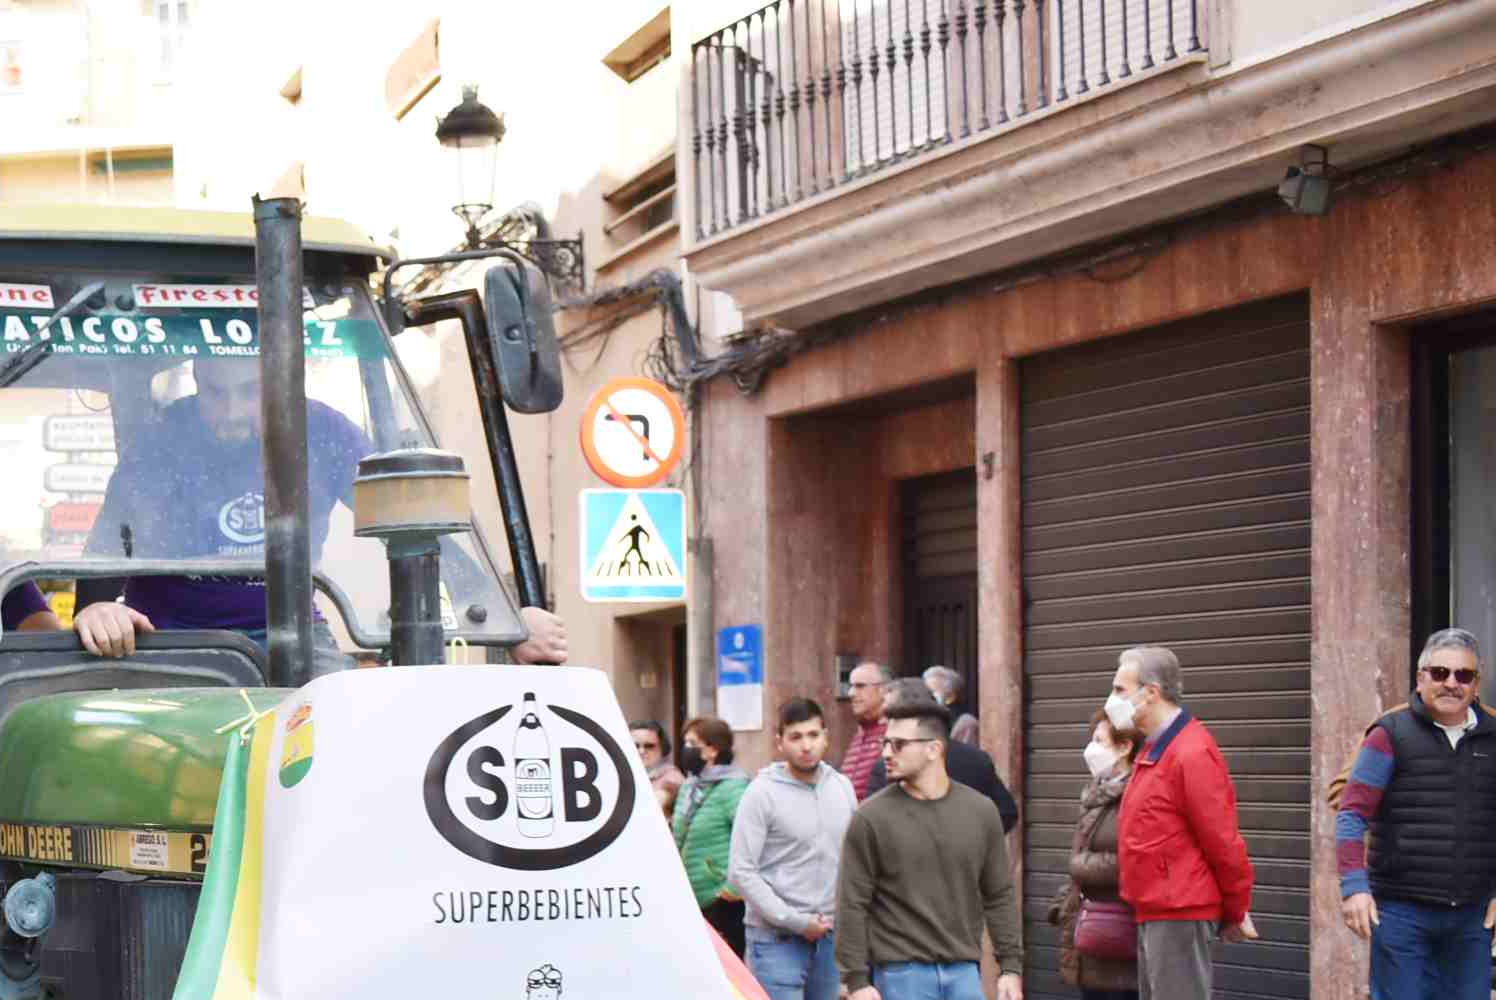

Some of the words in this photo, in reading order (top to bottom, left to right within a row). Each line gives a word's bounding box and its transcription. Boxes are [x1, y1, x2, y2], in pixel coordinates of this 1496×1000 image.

[136, 286, 259, 305] Firesto
[199, 318, 344, 346] LOZ
[464, 745, 509, 821] S
[560, 747, 603, 822] B
[27, 825, 73, 862] DEERE
[432, 886, 643, 924] SUPERBEBIENTES
